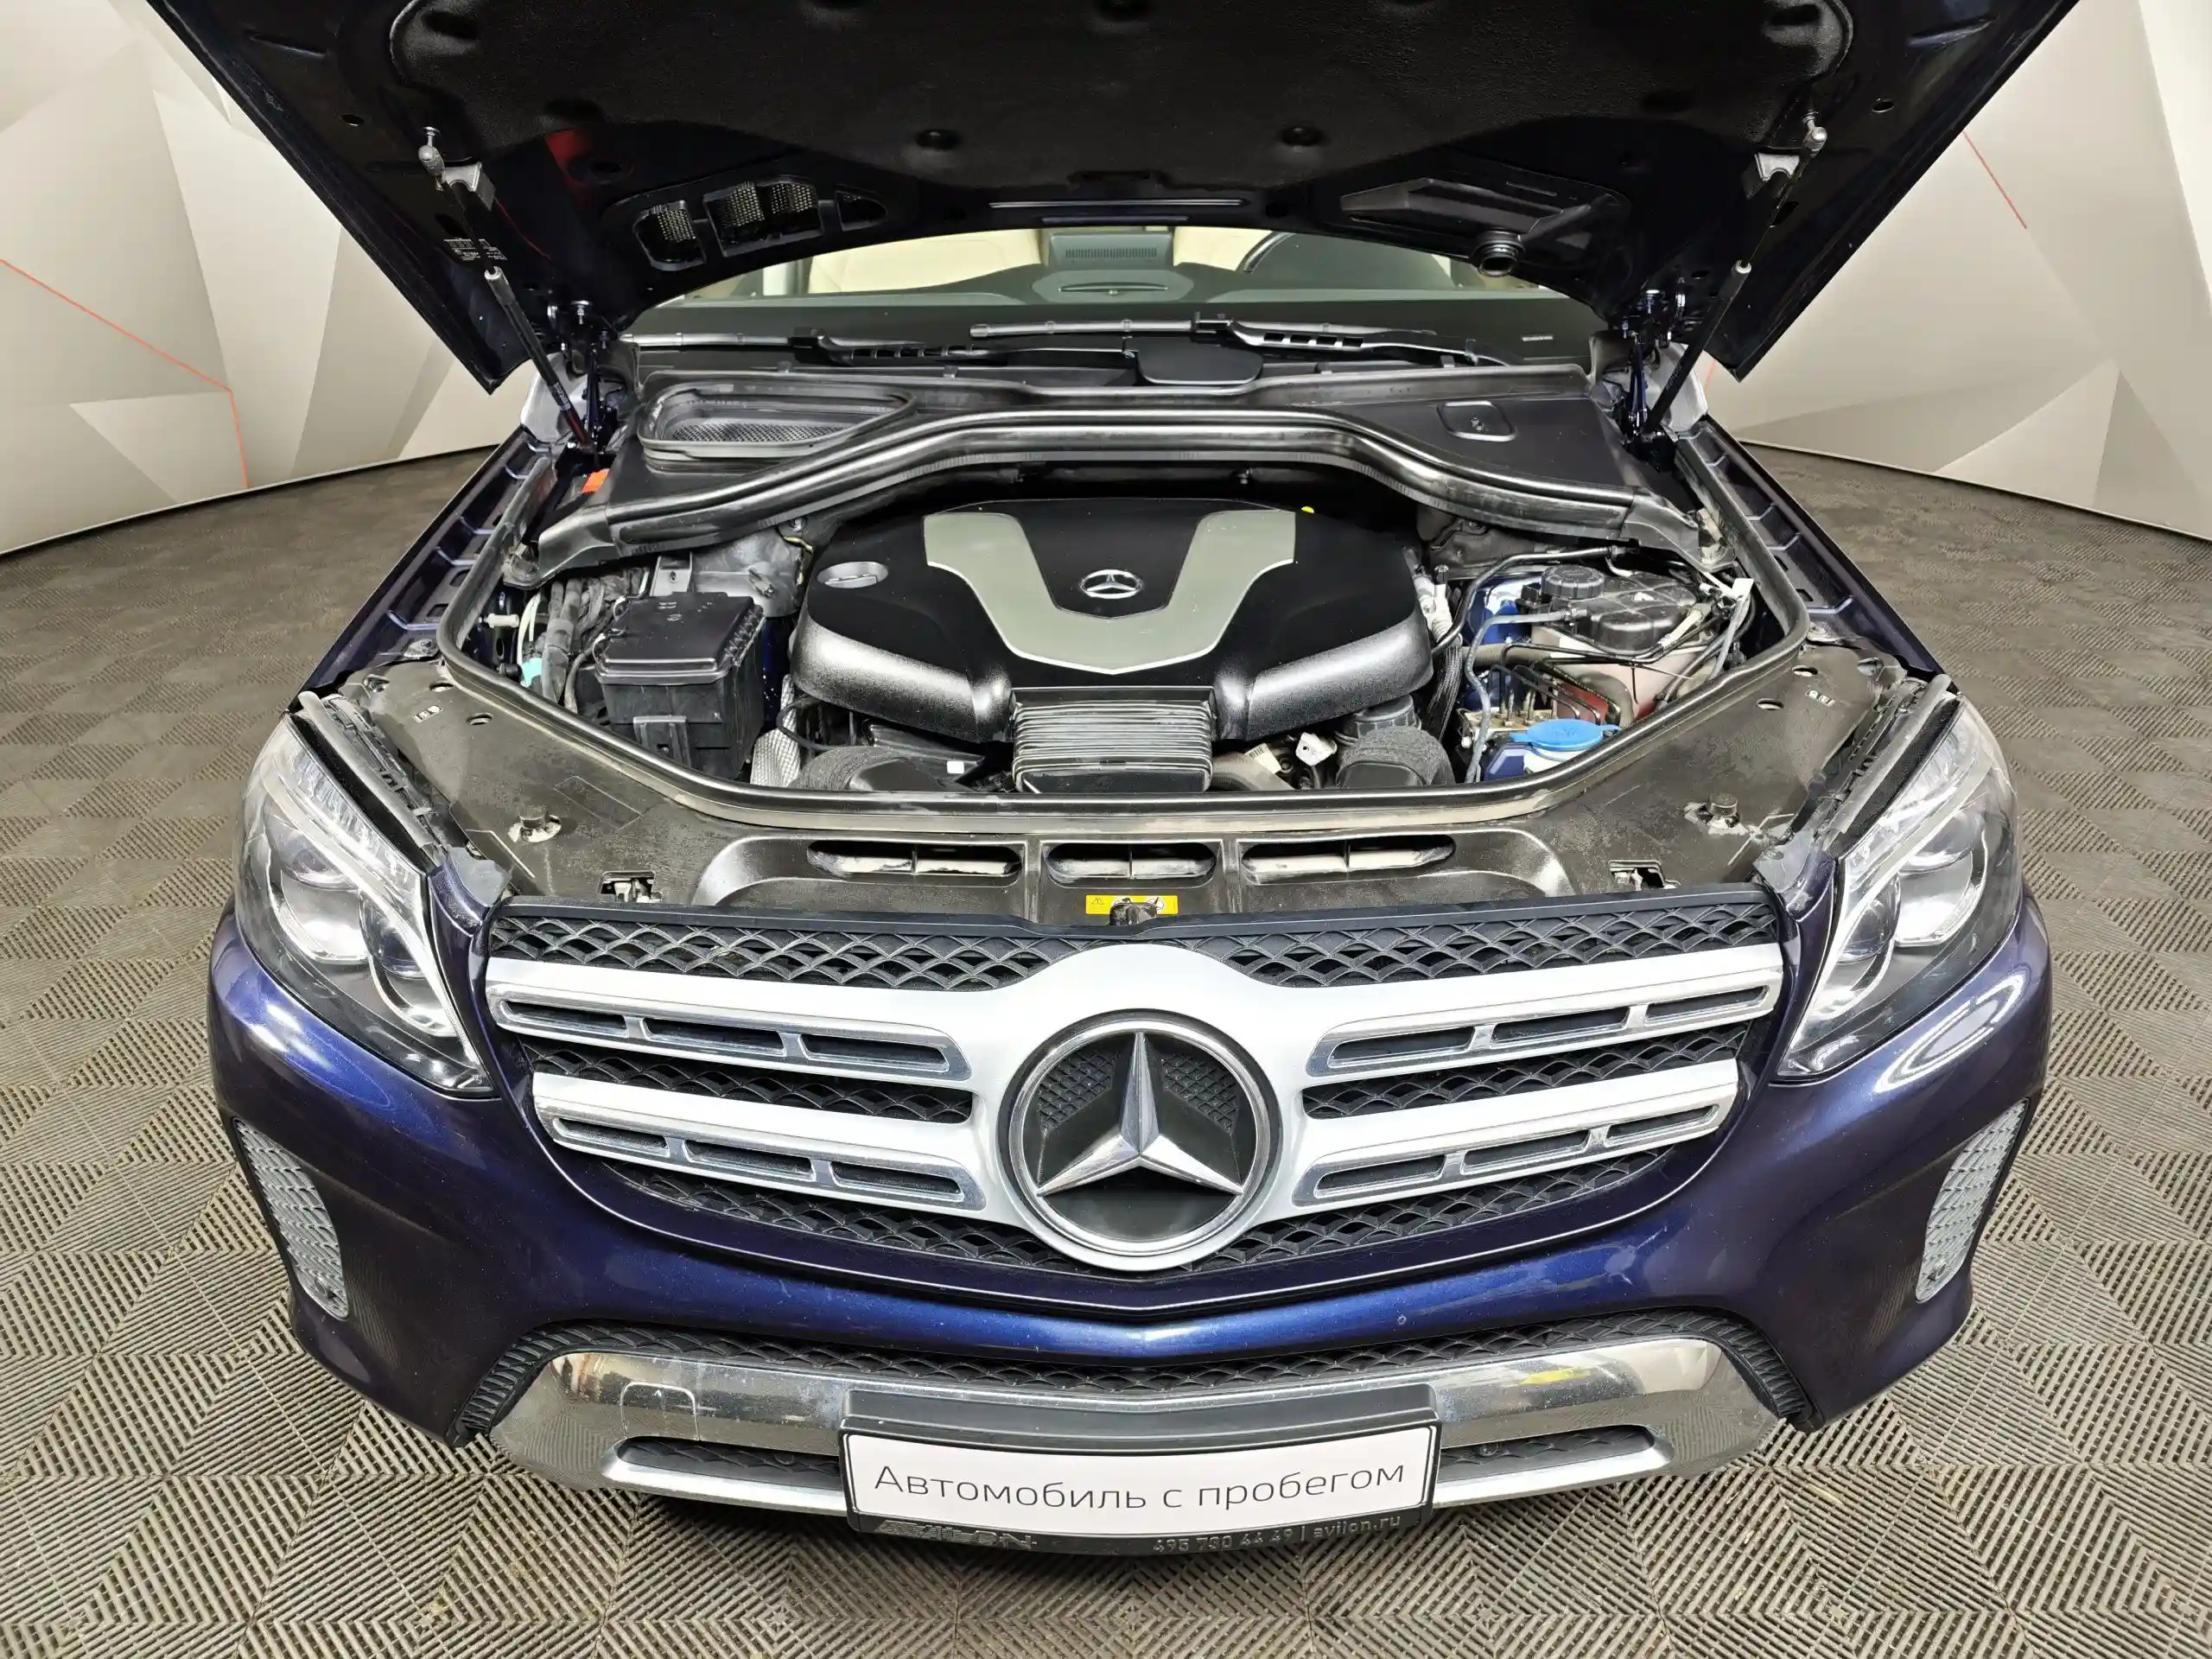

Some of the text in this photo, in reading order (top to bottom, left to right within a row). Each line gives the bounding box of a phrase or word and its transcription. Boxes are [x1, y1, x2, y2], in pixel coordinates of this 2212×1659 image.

[874, 1465, 1404, 1510] Автомобиль с пробегом
[1153, 1537, 1189, 1554] 495
